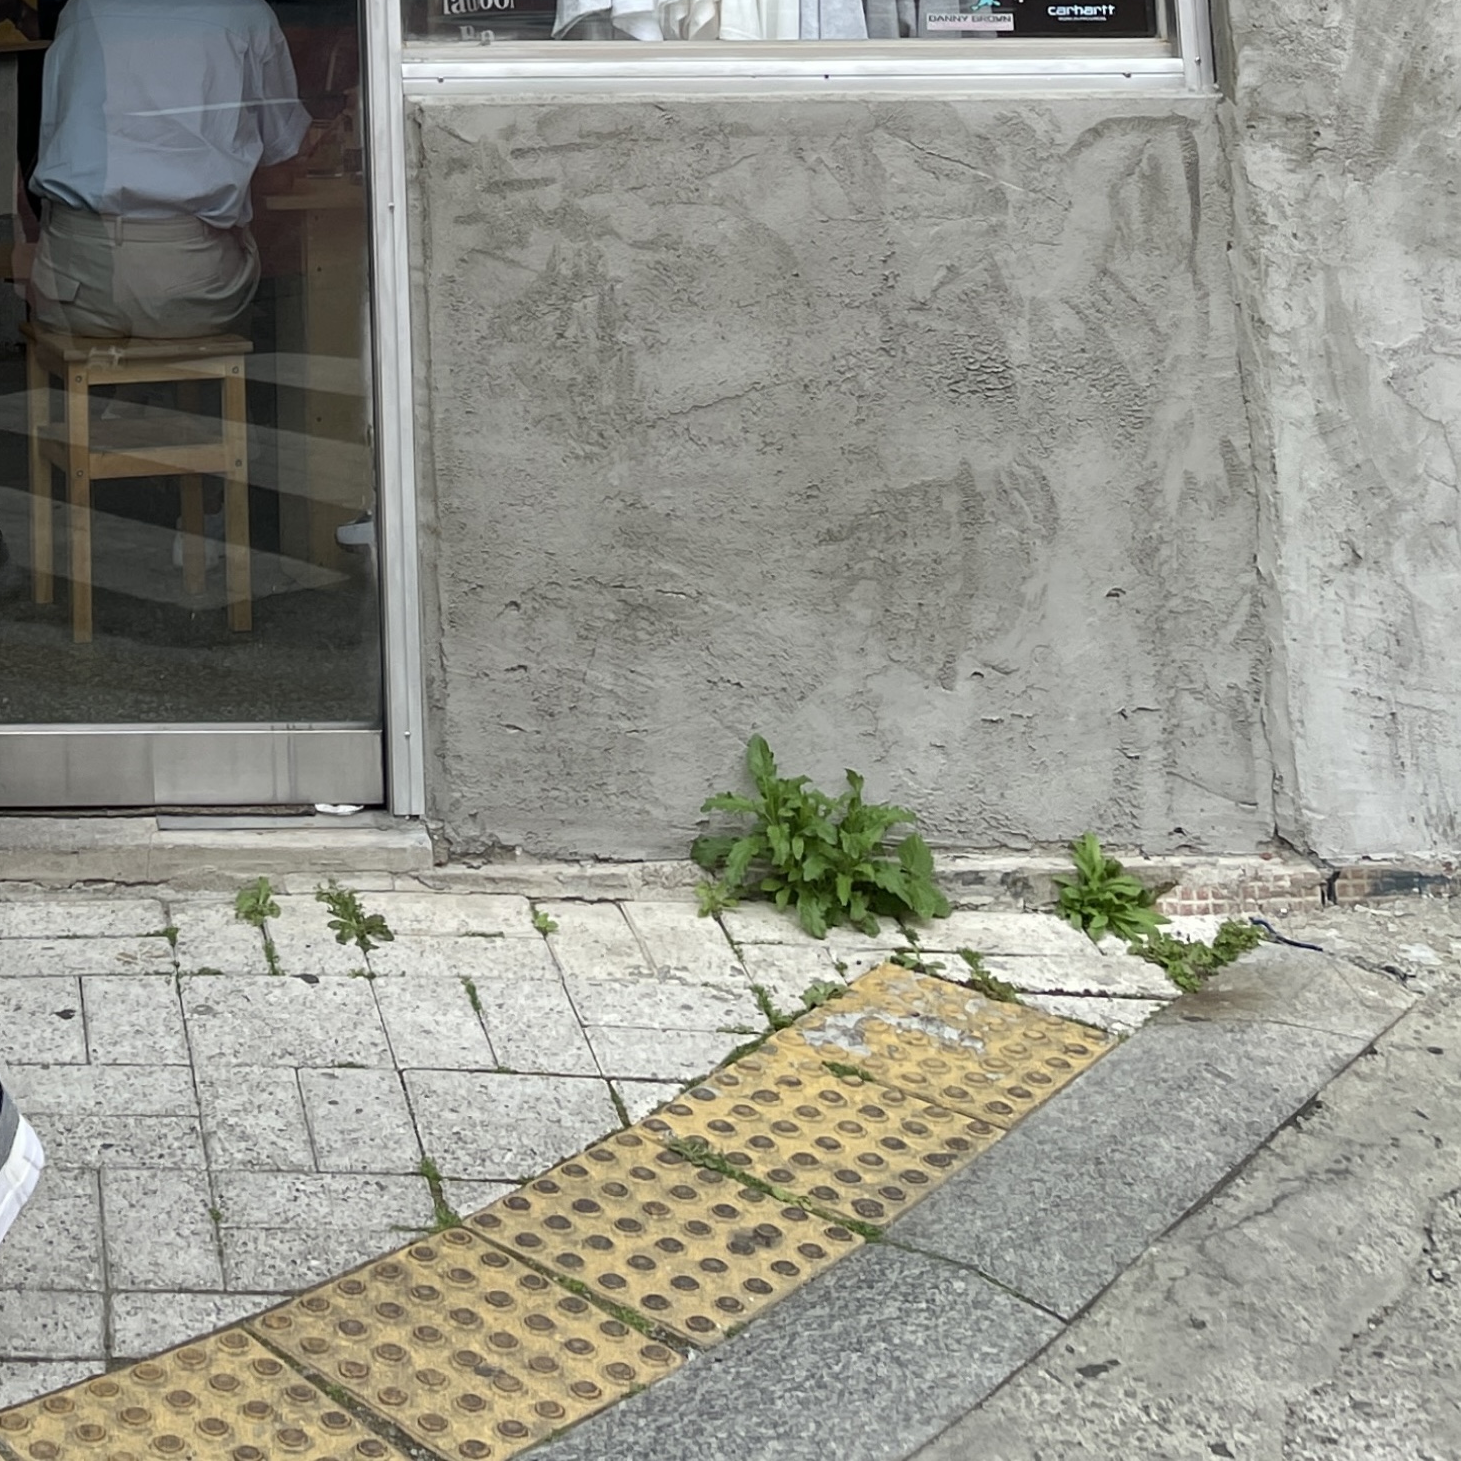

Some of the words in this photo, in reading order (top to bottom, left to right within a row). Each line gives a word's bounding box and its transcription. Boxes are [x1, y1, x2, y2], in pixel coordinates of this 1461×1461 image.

[1047, 3, 1116, 16] carhartt
[928, 14, 969, 23] DANNY
[971, 14, 1012, 23] BROWN
